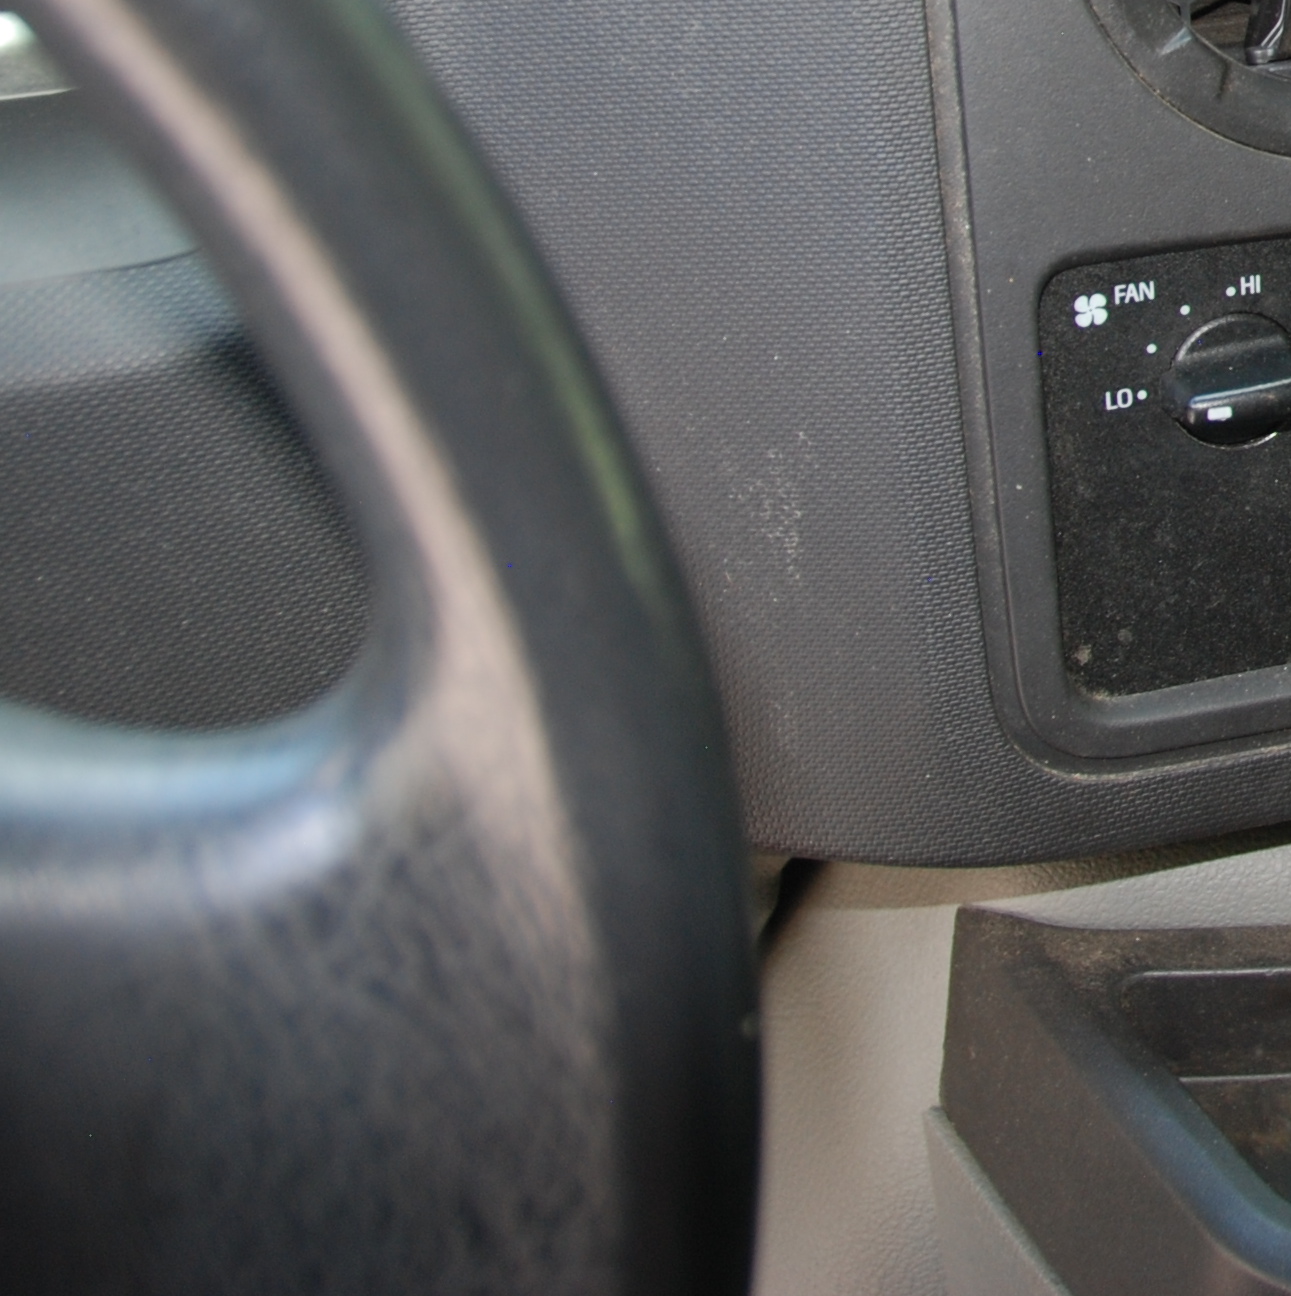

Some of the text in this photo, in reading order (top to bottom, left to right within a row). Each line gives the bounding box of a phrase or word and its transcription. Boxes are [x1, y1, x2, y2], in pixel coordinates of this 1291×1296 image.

[1114, 280, 1155, 305] FAN
[1240, 274, 1261, 296] HI
[1105, 388, 1133, 411] LO
